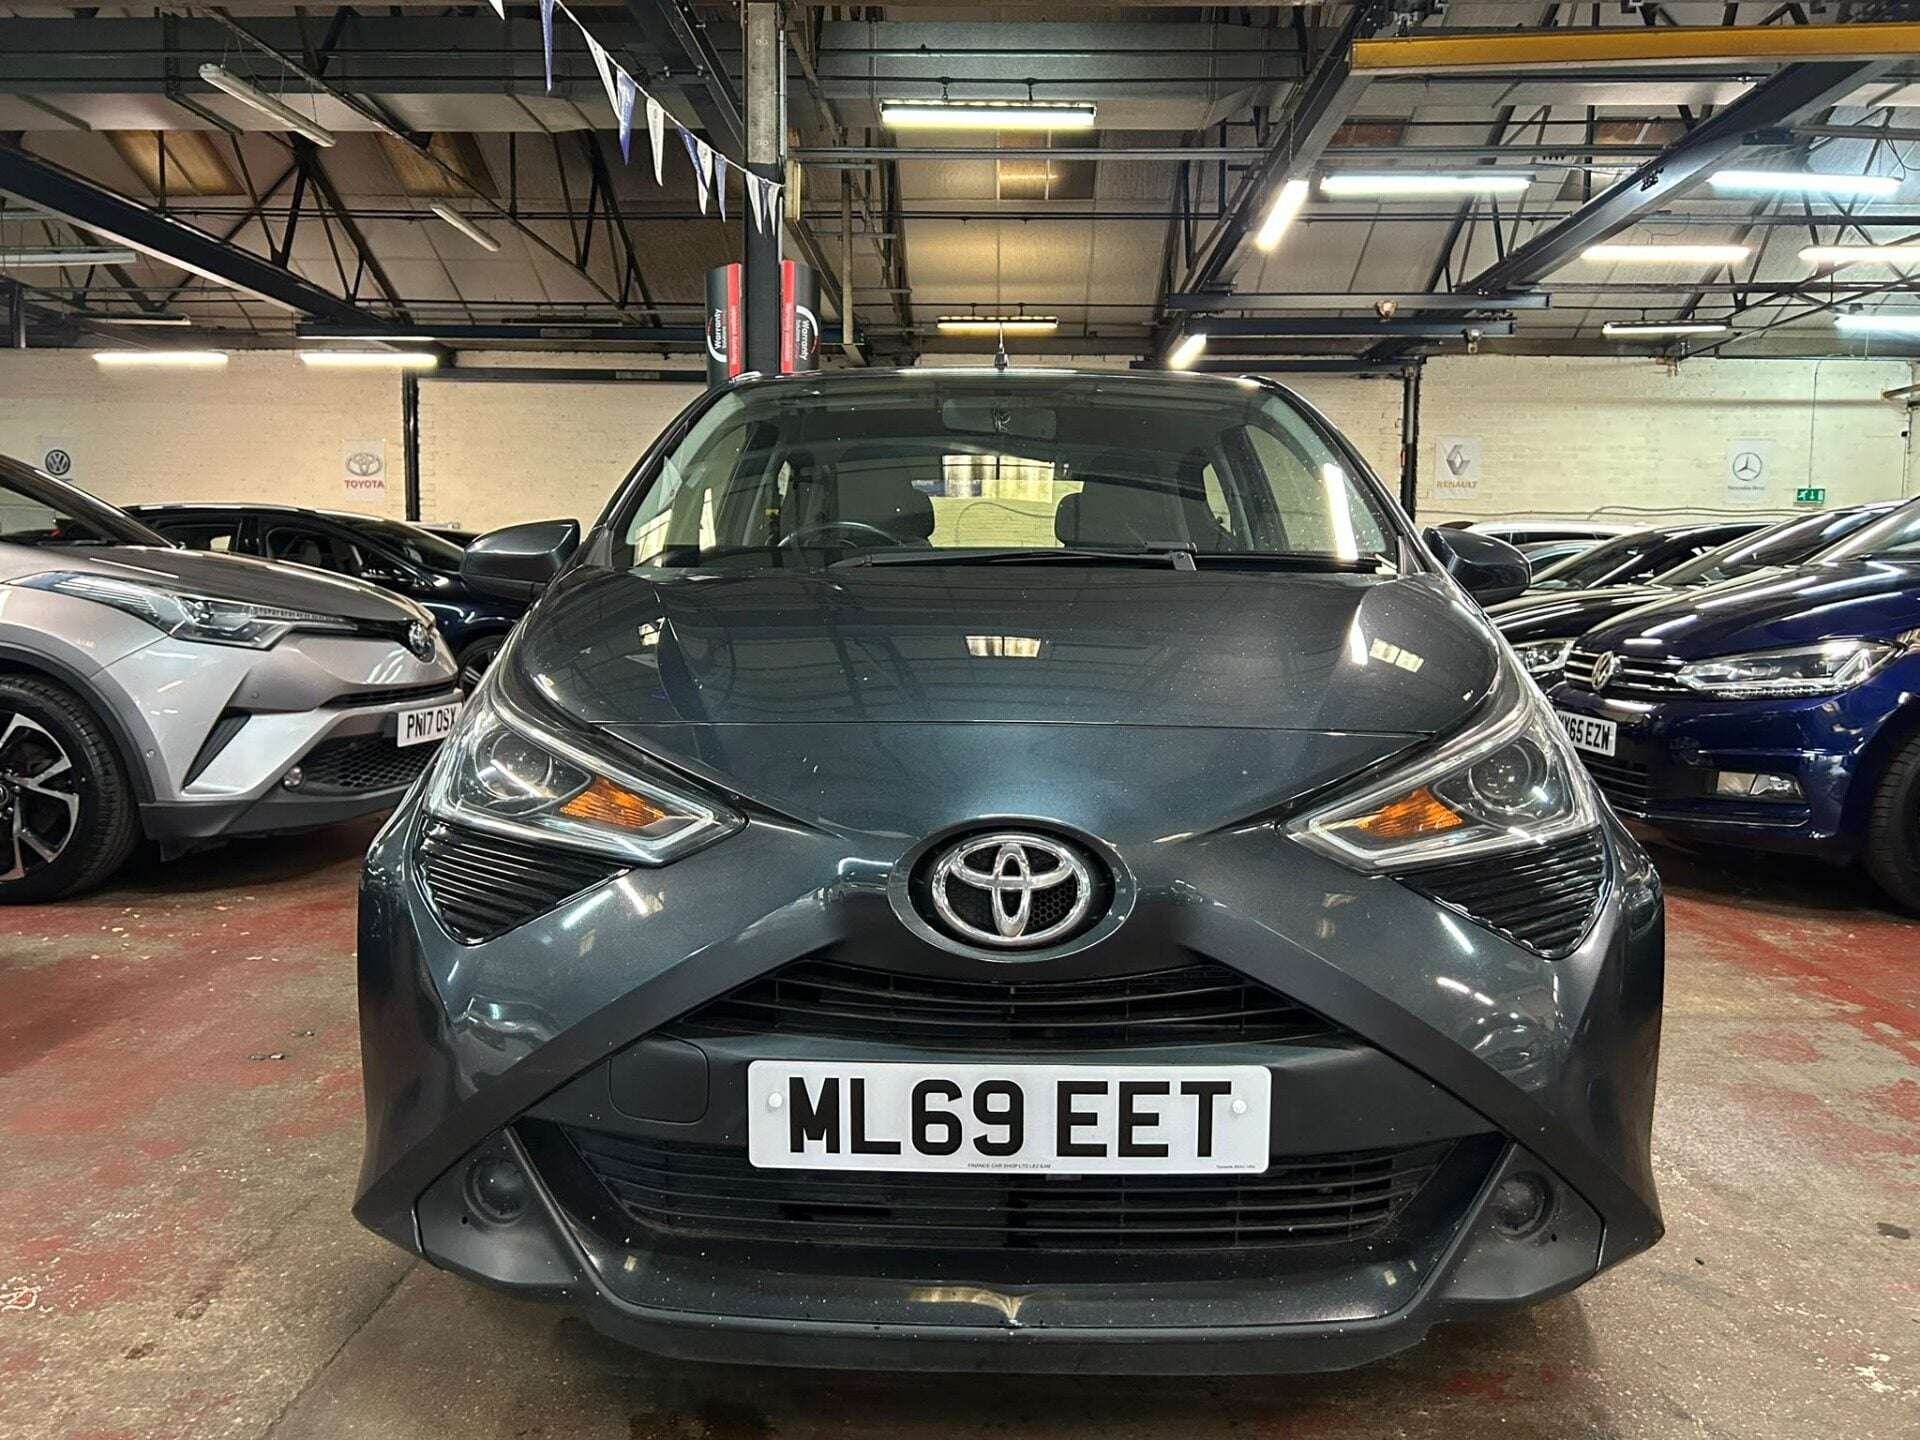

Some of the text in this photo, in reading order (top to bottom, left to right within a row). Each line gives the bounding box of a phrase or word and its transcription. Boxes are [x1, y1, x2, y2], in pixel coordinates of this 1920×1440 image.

[714, 308, 723, 350] Warranty
[800, 320, 810, 361] Warranty
[344, 480, 385, 488] TOYOTA
[407, 707, 456, 739] PN17 OSX
[1585, 722, 1611, 750] EZW
[789, 1076, 1232, 1158] ML69 EET
